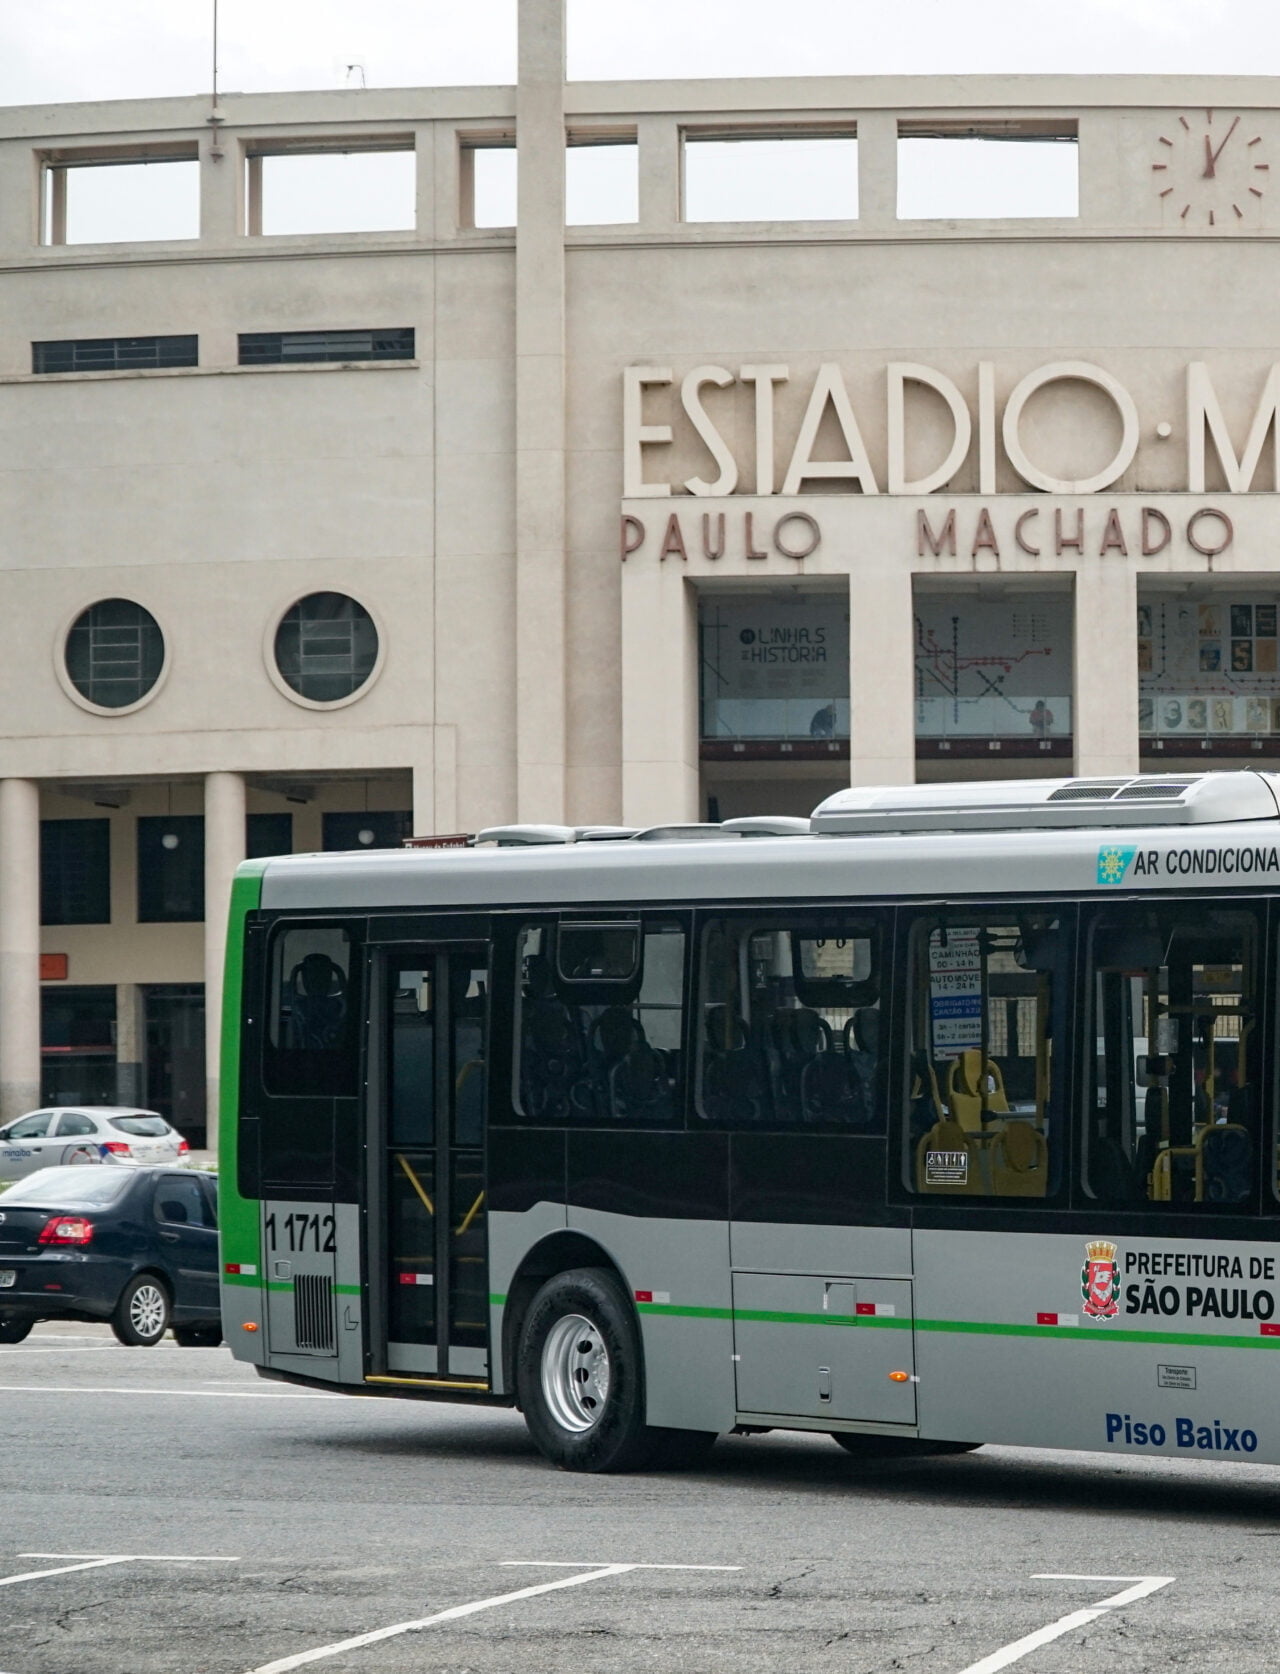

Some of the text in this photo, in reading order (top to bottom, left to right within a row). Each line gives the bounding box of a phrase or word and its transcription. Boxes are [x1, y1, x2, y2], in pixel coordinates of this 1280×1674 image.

[622, 361, 1139, 496] ESTADIO
[621, 511, 821, 561] PAULO
[916, 508, 1233, 556] MACHADO
[758, 627, 826, 644] LINHAS
[1134, 850, 1159, 875] AR
[266, 1213, 336, 1252] 1 1712
[1125, 1252, 1275, 1280] PREFEITURA DE
[1125, 1278, 1275, 1320] SÃO PAULO
[1105, 1413, 1258, 1452] Piso Baixo
